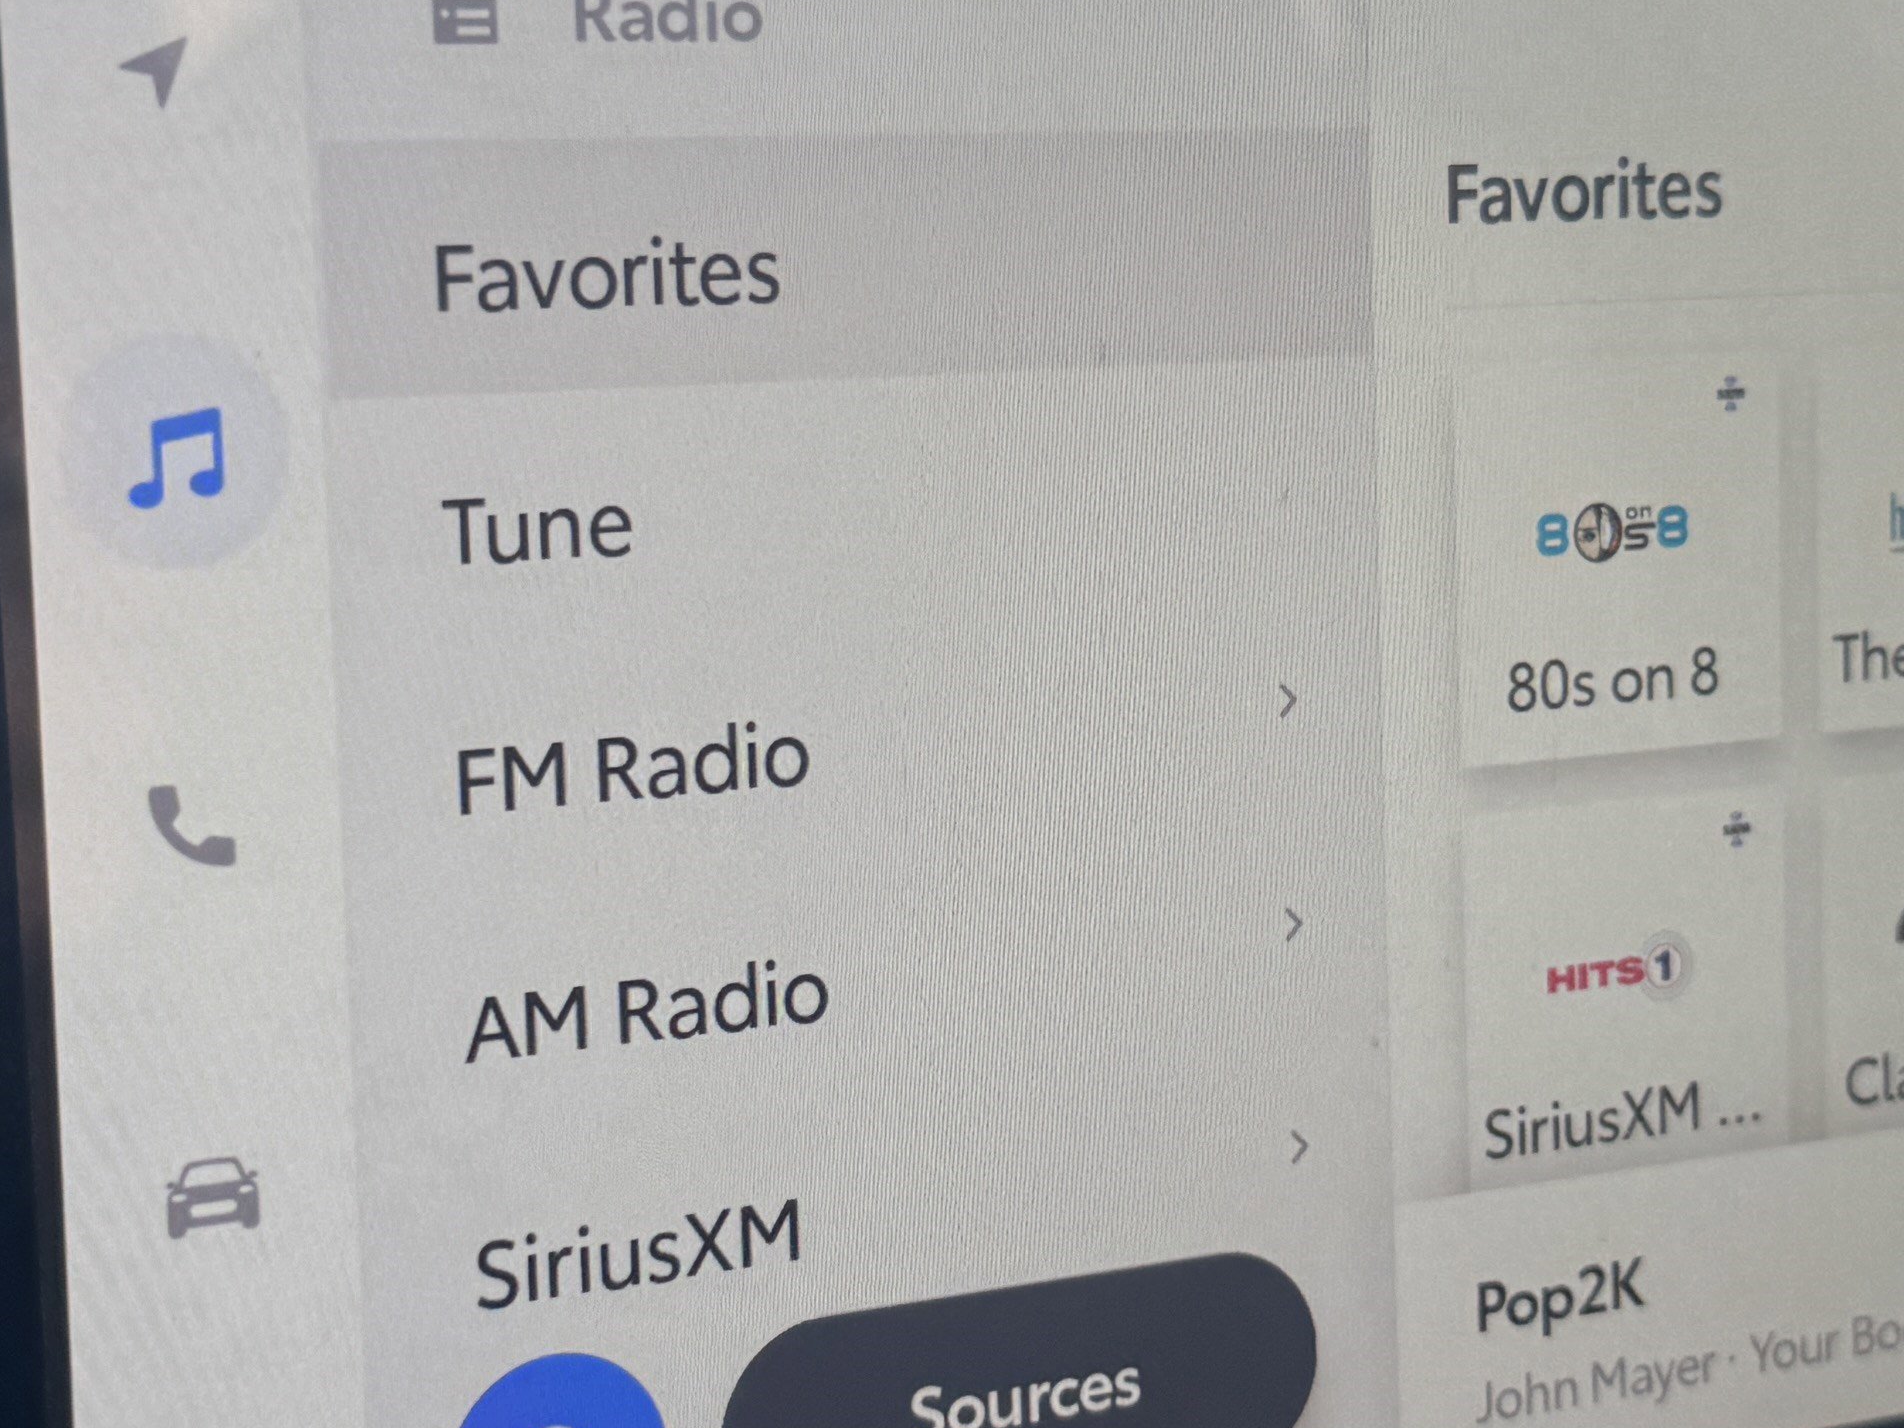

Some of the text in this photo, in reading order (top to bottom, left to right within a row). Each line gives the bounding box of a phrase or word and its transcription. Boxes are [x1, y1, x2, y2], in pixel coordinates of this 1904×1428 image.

[1447, 158, 1724, 226] Favorites
[434, 236, 782, 313] Favorites
[441, 495, 635, 566] Tune
[1507, 647, 1720, 714] 80s on 8
[456, 719, 812, 817] FM Radio
[465, 959, 832, 1064] AM Radio
[1547, 956, 1646, 994] HITS
[1484, 1082, 1700, 1162] SiriusXM
[476, 1199, 803, 1310] SiriusXM
[1477, 1256, 1646, 1336] Pop2K
[1476, 1373, 1579, 1424] John
[1592, 1352, 1717, 1405] Mayer
[1750, 1330, 1840, 1373] Your
